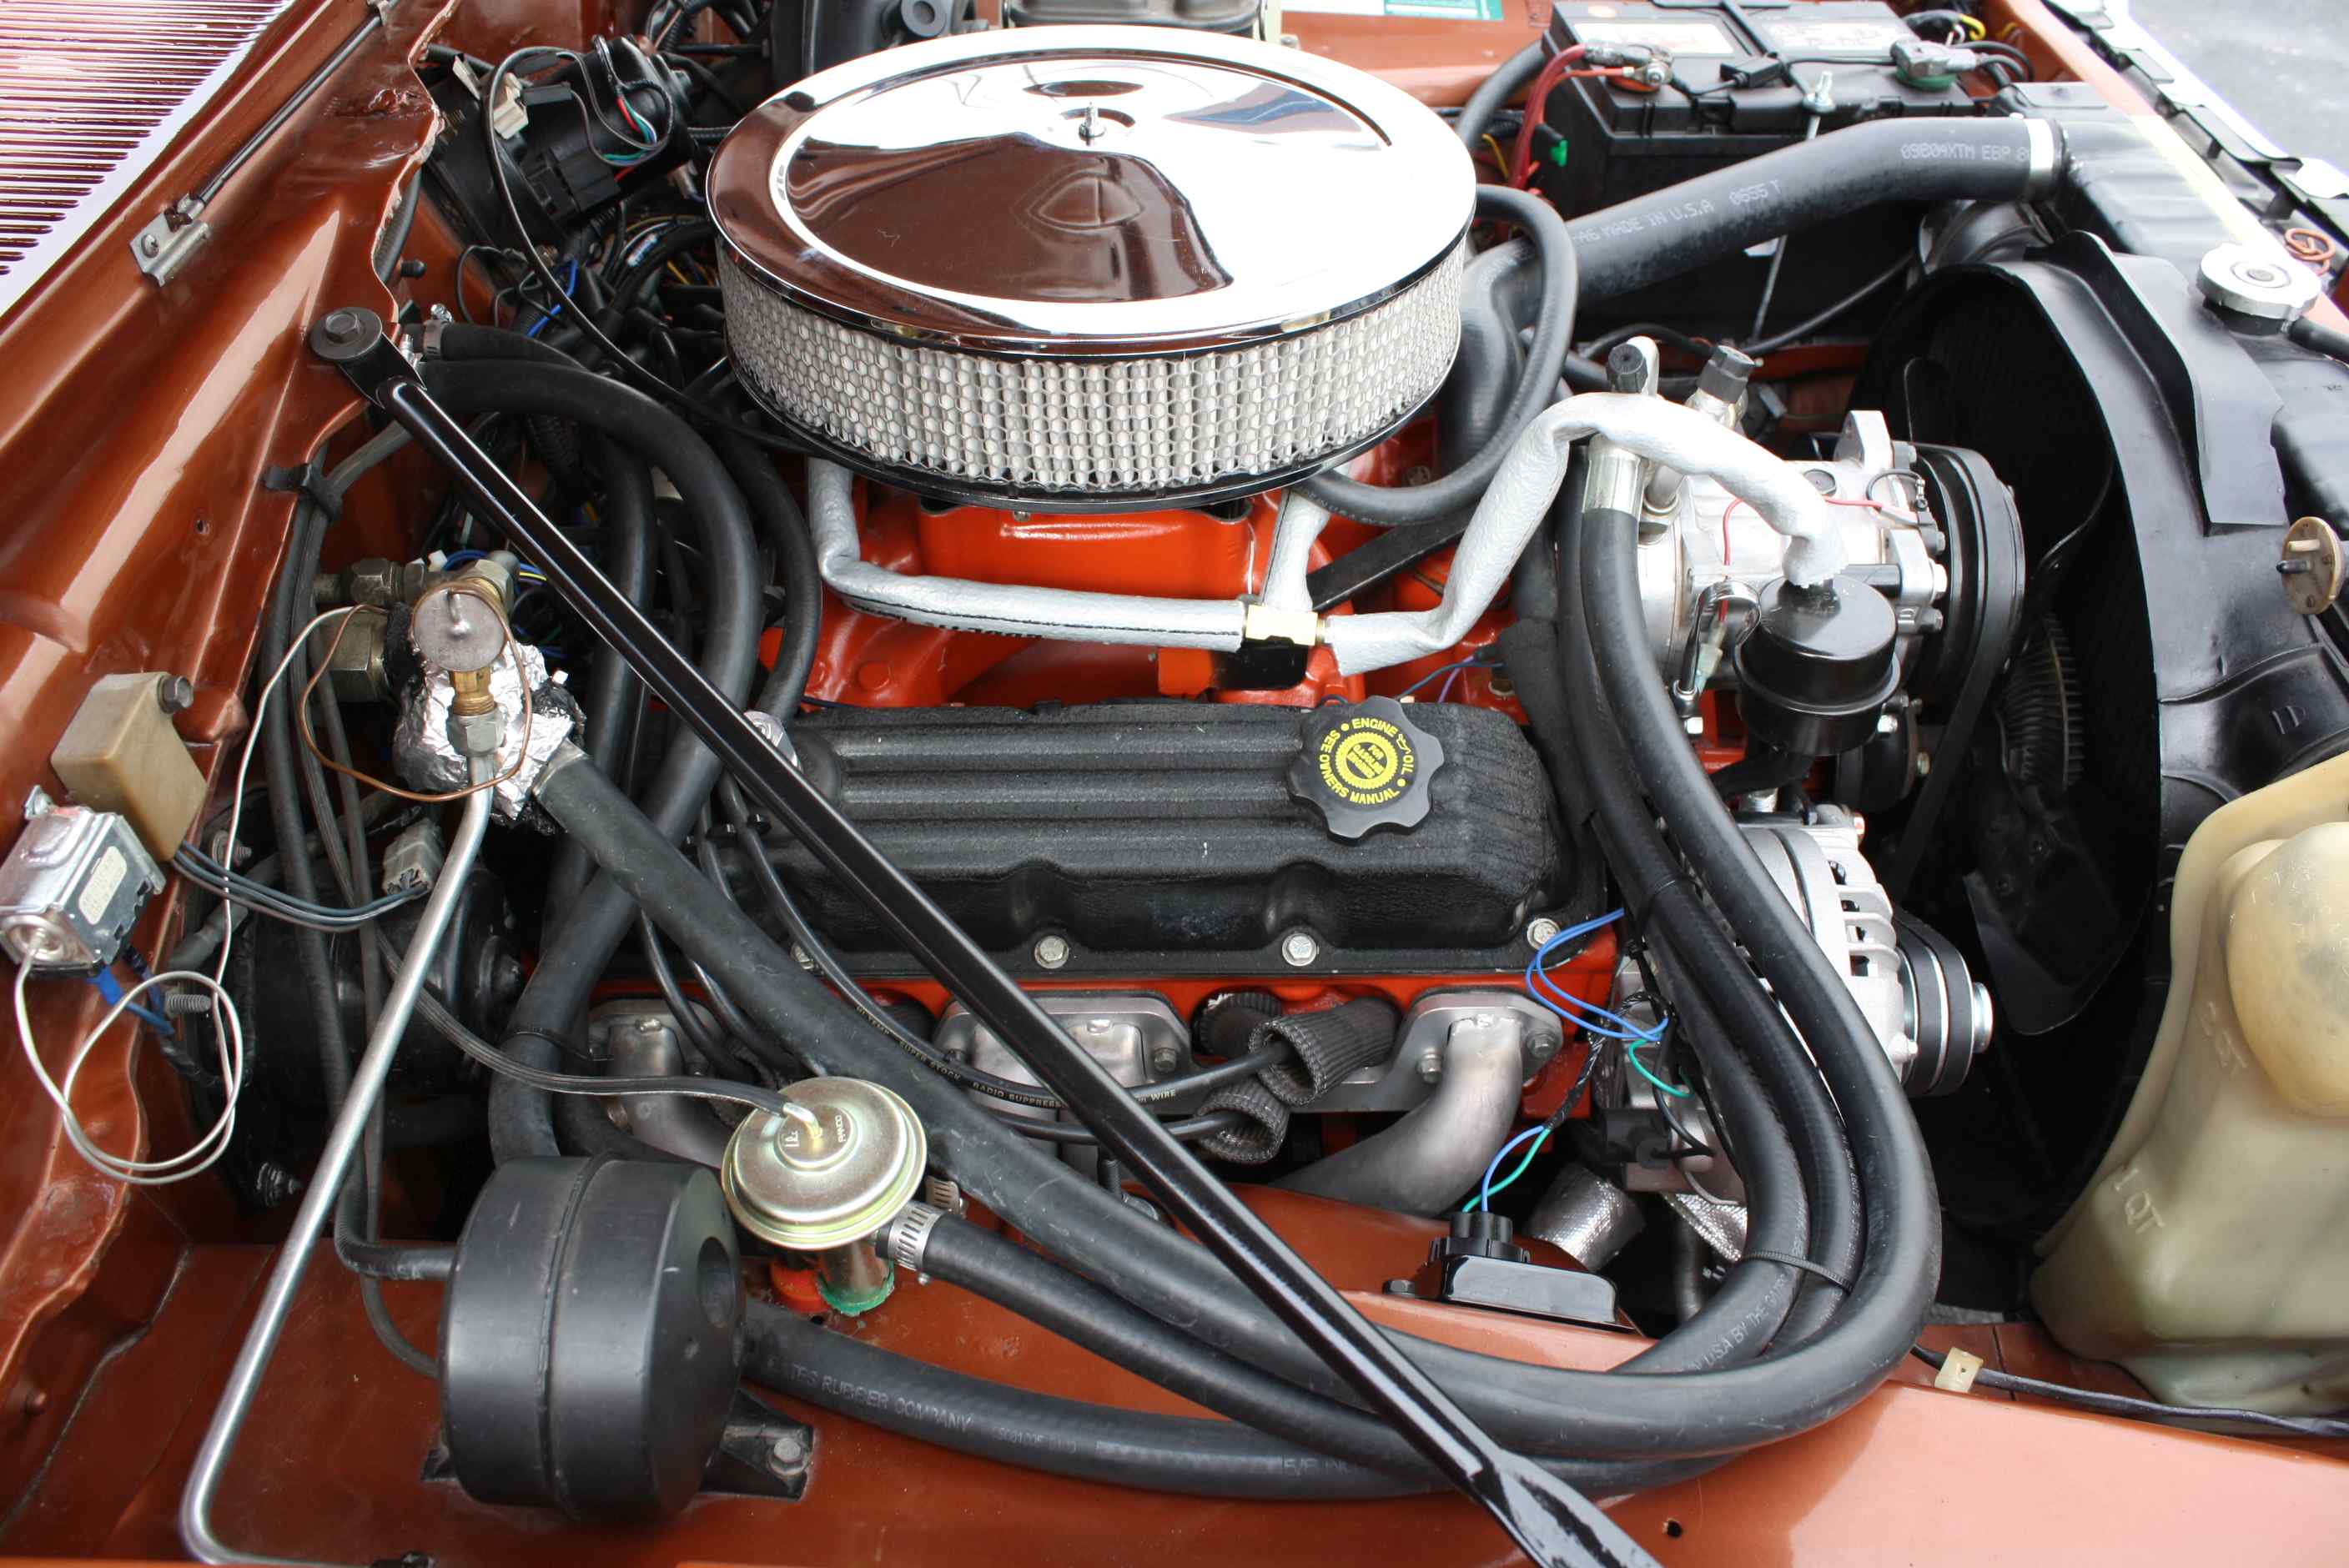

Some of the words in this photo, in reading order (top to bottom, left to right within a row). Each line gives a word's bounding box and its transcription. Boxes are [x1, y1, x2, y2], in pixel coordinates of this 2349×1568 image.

[1647, 211, 1668, 228] IN
[1321, 730, 1340, 754] SEE
[1351, 717, 1399, 736] ENGINE
[1401, 755, 1415, 775] OIL
[1320, 755, 1349, 798] OWNERS
[1350, 788, 1400, 805] MANUAL
[899, 1040, 928, 1063] SUPER
[929, 1060, 961, 1081] STOCK
[973, 1082, 1004, 1098] RADIO
[1150, 1088, 1176, 1102] WIRE
[2125, 1190, 2165, 1234] QT
[1731, 1321, 1749, 1344] BY
[1746, 1304, 1768, 1329] THE
[822, 1376, 889, 1410] RUBBER
